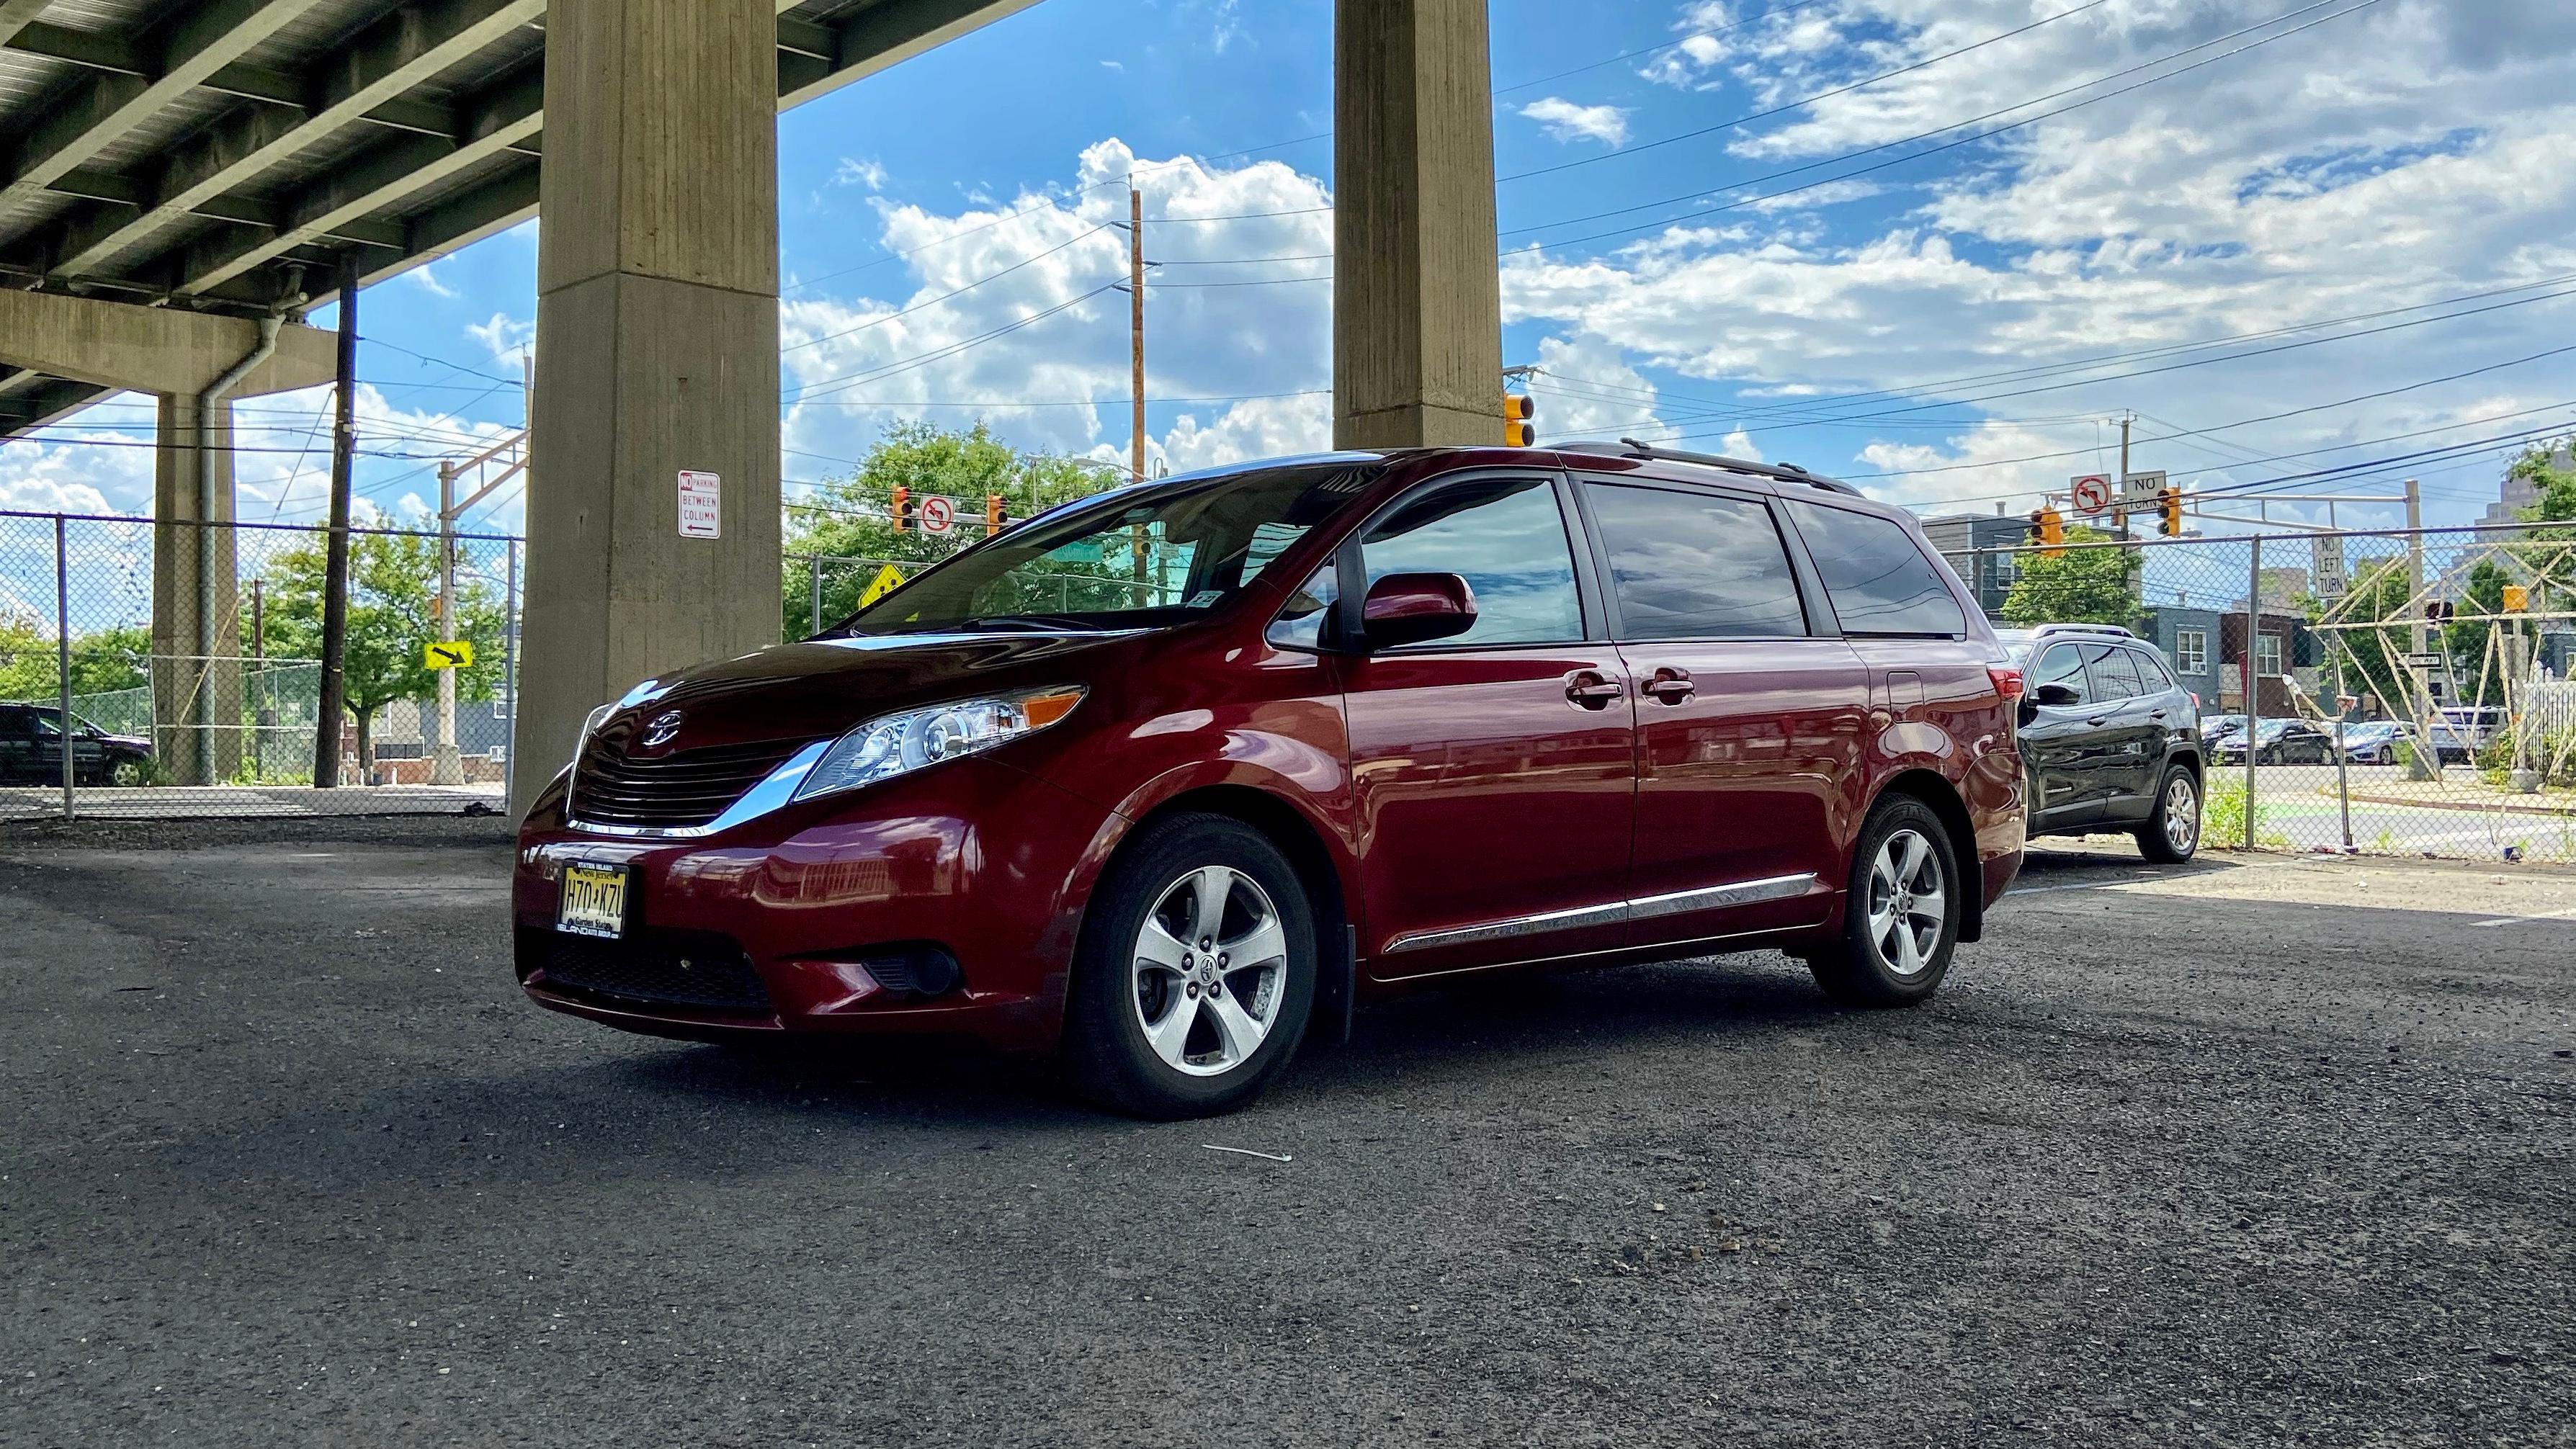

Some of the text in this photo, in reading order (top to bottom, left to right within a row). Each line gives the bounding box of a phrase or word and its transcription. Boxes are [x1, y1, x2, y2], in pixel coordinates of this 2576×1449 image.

[681, 475, 717, 488] NO PARKING
[2135, 477, 2155, 490] NO
[683, 495, 716, 507] BETWEEN
[684, 510, 715, 521] COLUMN
[2322, 537, 2335, 552] NO
[2319, 557, 2340, 573] LEFT
[2320, 578, 2343, 593] TURN
[580, 869, 614, 880] New Jersey
[576, 917, 594, 927] Garden
